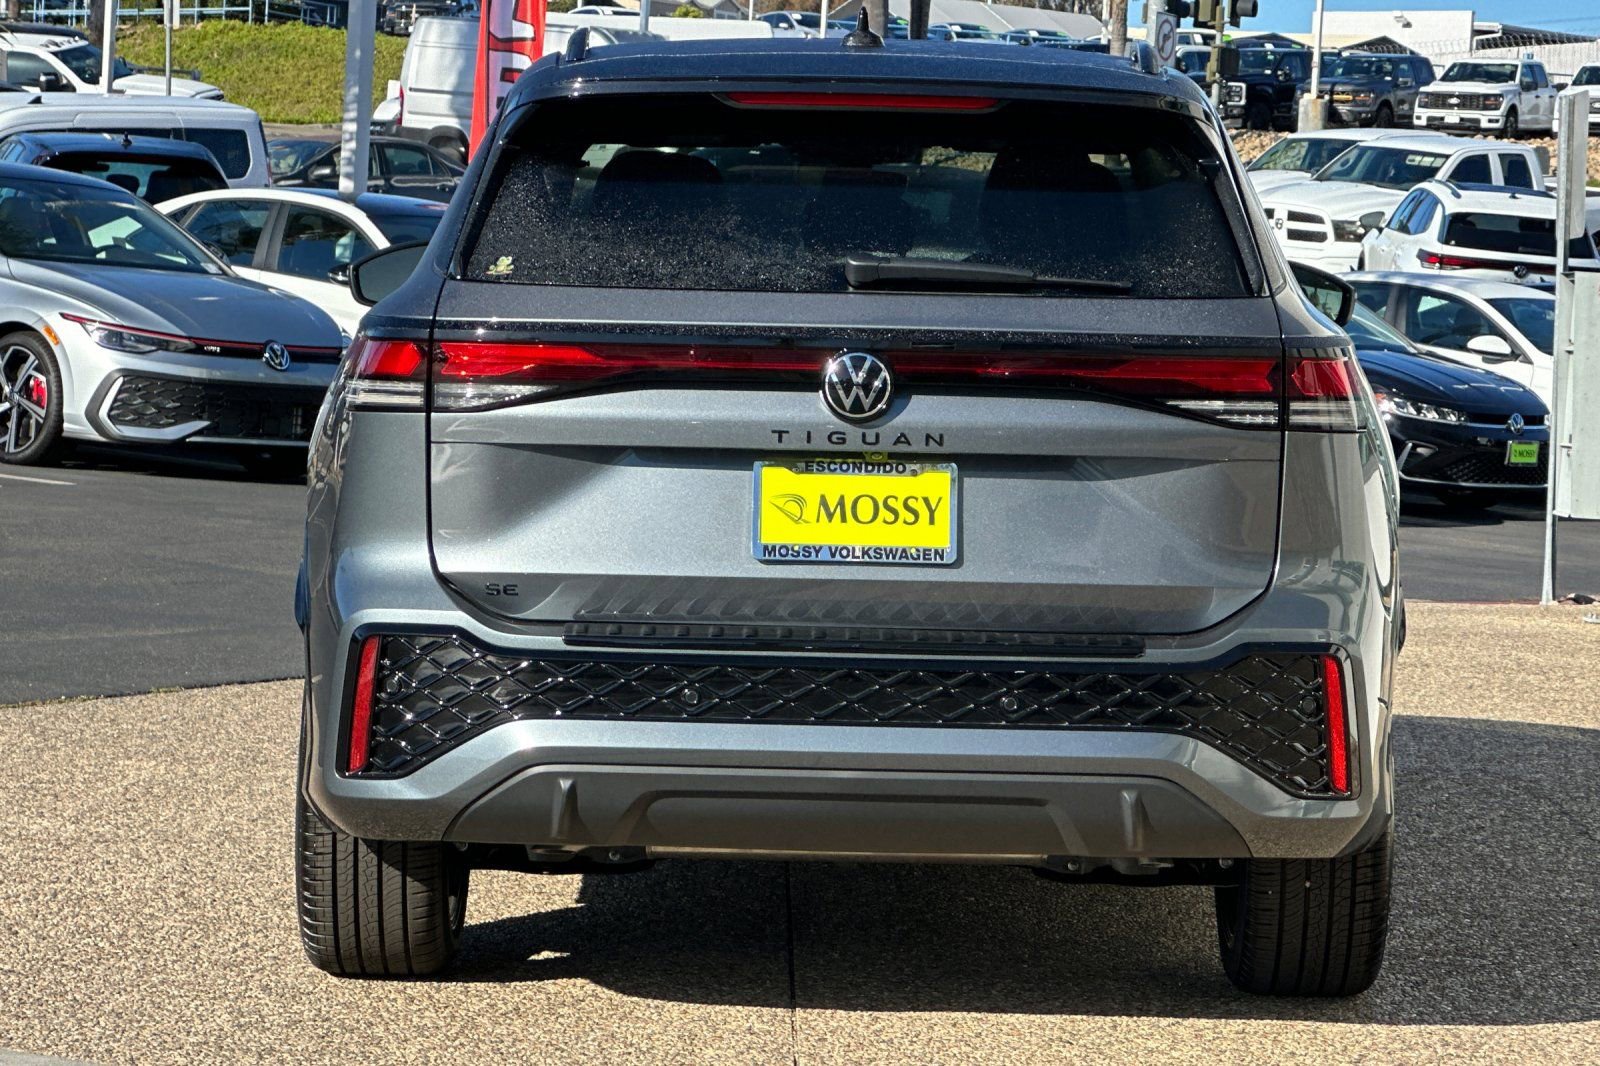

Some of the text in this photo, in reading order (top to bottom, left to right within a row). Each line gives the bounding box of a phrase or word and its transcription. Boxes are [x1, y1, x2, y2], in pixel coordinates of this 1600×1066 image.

[825, 352, 891, 418] VW
[771, 429, 945, 447] TIGUAN
[804, 460, 907, 475] ESCONDIDO
[815, 493, 943, 526] MOSSY
[762, 545, 945, 562] MOSSY VOLKSWAGEN
[485, 583, 519, 596] SE
